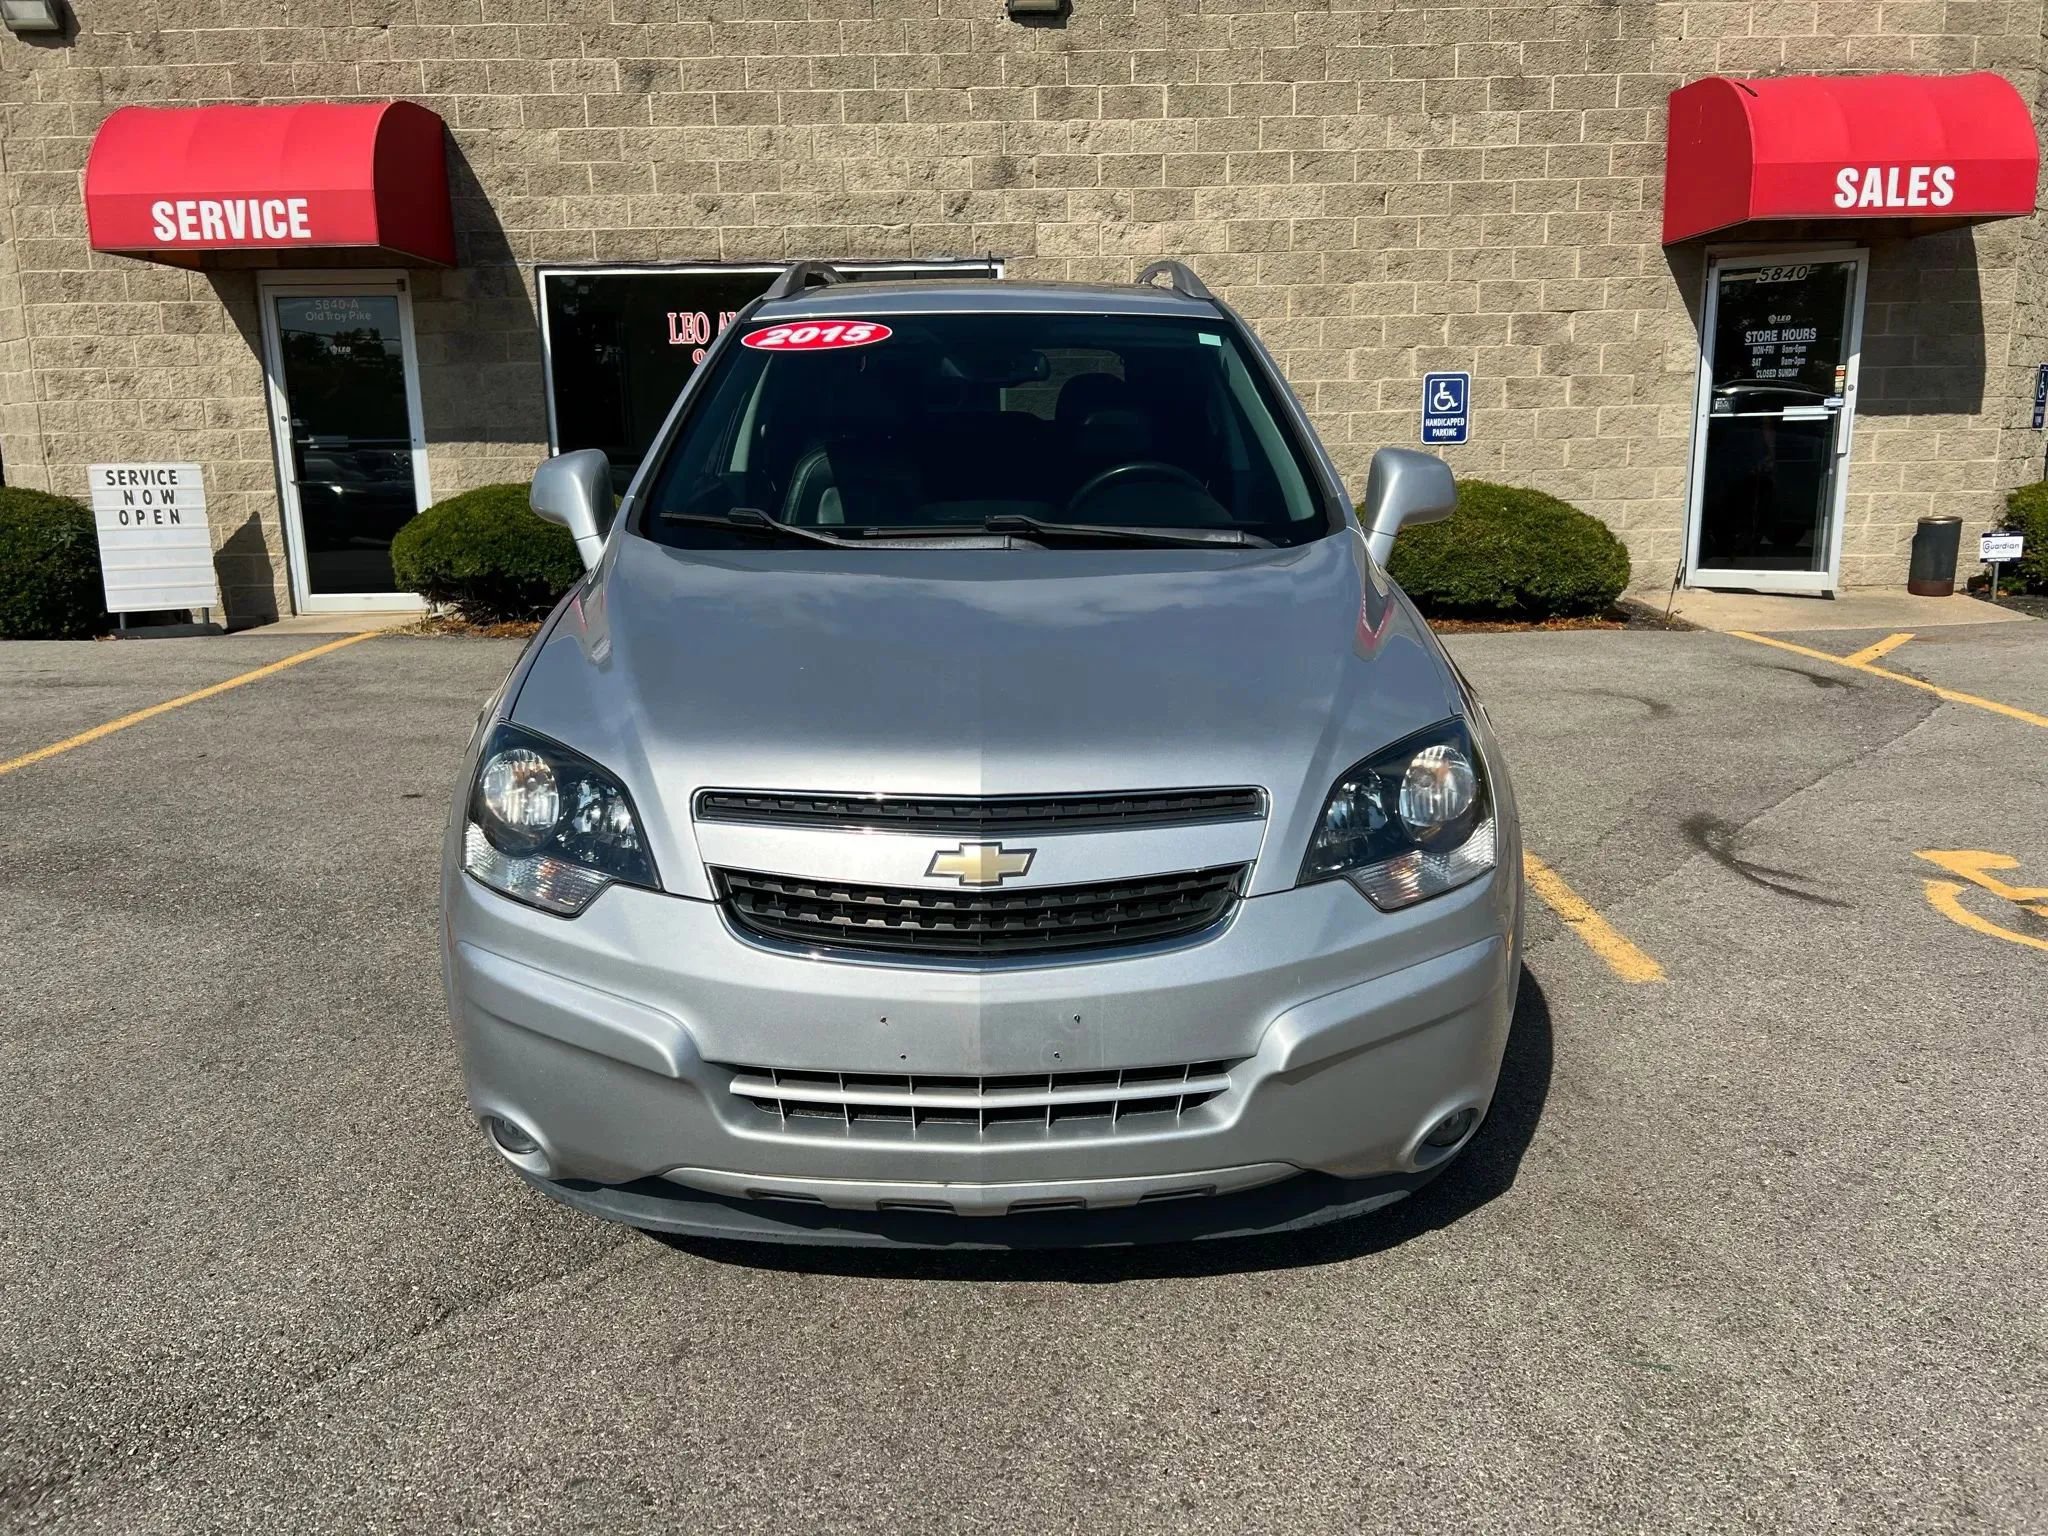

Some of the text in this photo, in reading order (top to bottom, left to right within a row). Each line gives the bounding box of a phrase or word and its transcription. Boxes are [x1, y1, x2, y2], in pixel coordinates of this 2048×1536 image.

[1834, 165, 1955, 208] SALES
[151, 198, 312, 242] SERVICE
[1759, 265, 1808, 281] 5840
[315, 299, 360, 310] 5840-A
[305, 311, 372, 323] Old Troy Pike
[667, 311, 711, 345] LEO
[1745, 328, 1816, 343] STORE HOURS
[755, 325, 877, 347] 2015
[1753, 345, 1774, 354] MON-FRI
[1752, 358, 1762, 366] SAT
[1756, 368, 1799, 378] CLOSED SUNDAY
[1425, 417, 1465, 427] HANDICAPPED
[1432, 427, 1457, 437] PARKING
[105, 469, 178, 486] SERVICE
[123, 489, 175, 505] NOW
[119, 508, 180, 525] OPEN
